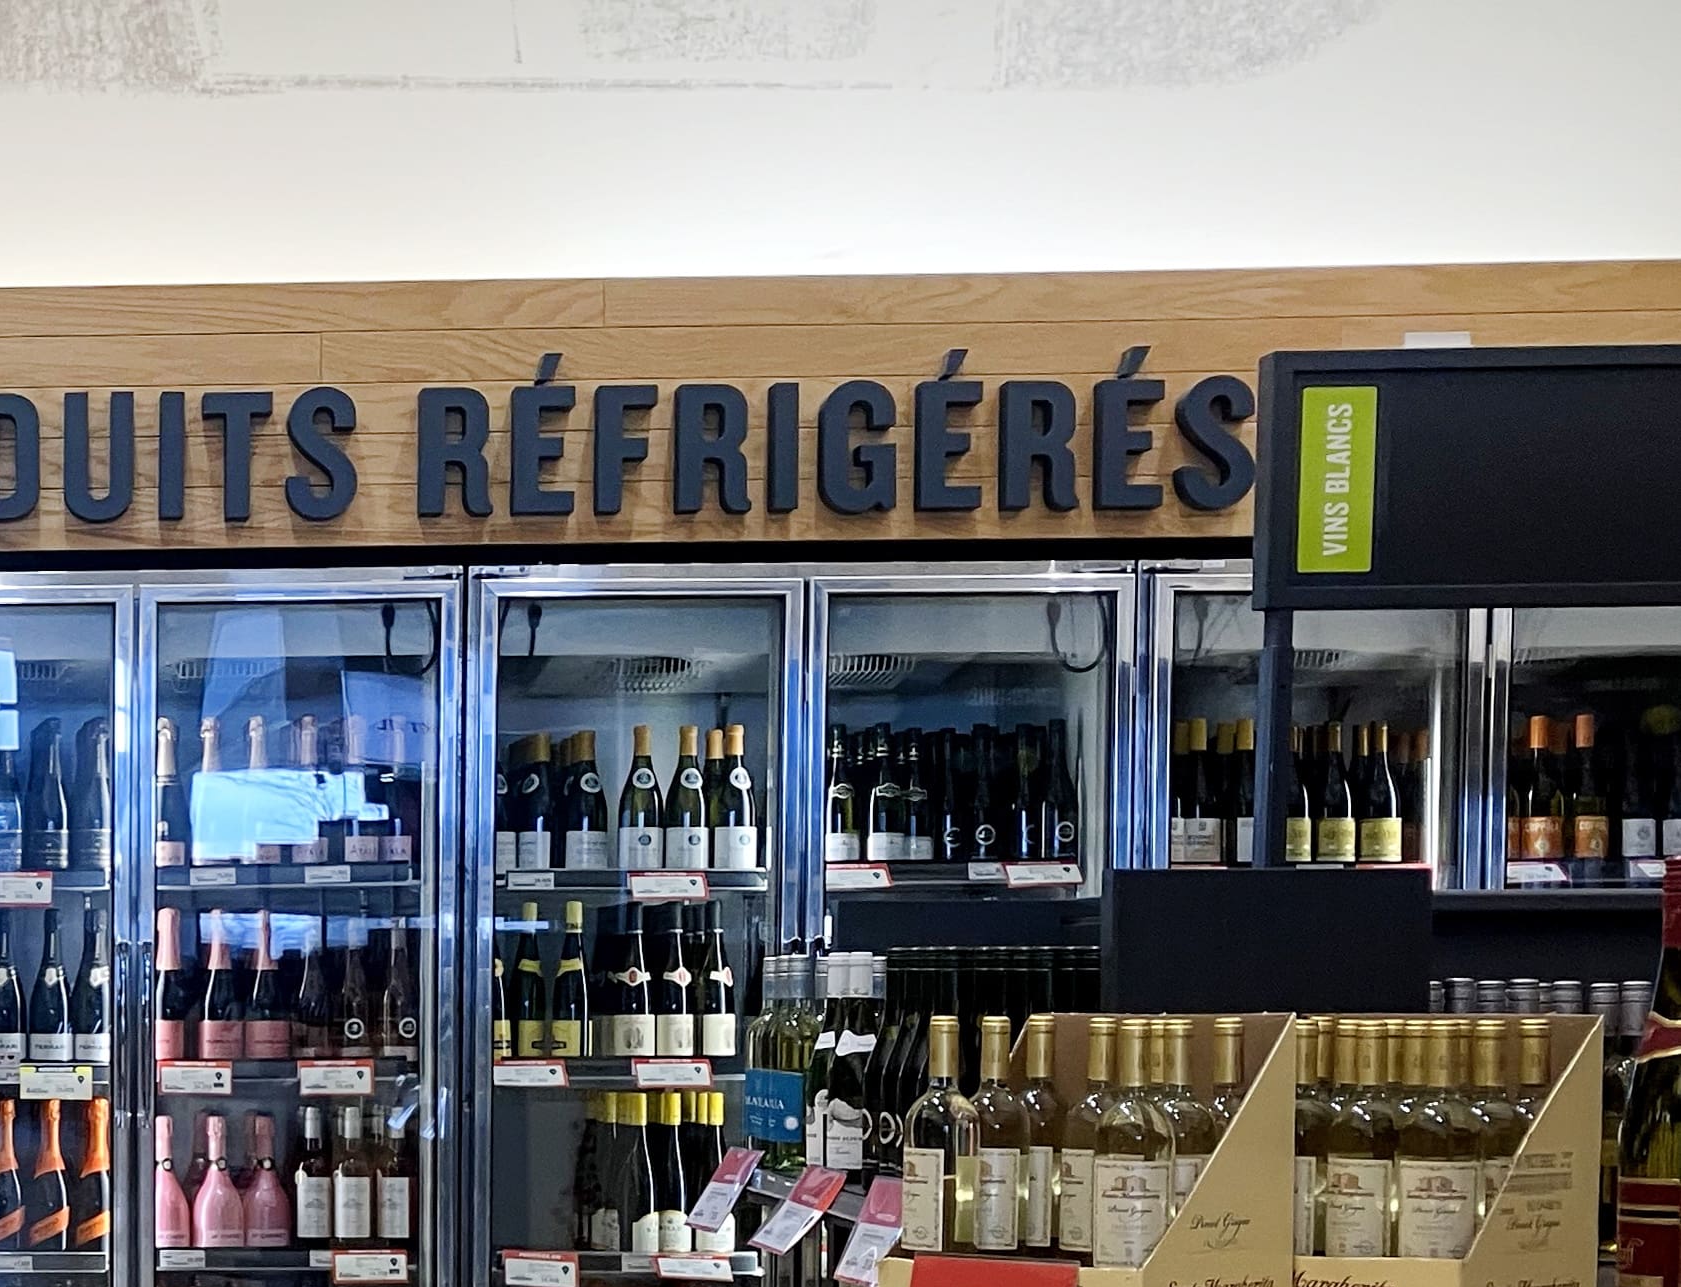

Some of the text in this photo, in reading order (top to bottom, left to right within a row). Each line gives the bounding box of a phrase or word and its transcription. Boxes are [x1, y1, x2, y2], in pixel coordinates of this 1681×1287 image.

[416, 345, 1257, 518] RÉFRIGÉRÉS
[1322, 404, 1353, 556] VINS BLANCS
